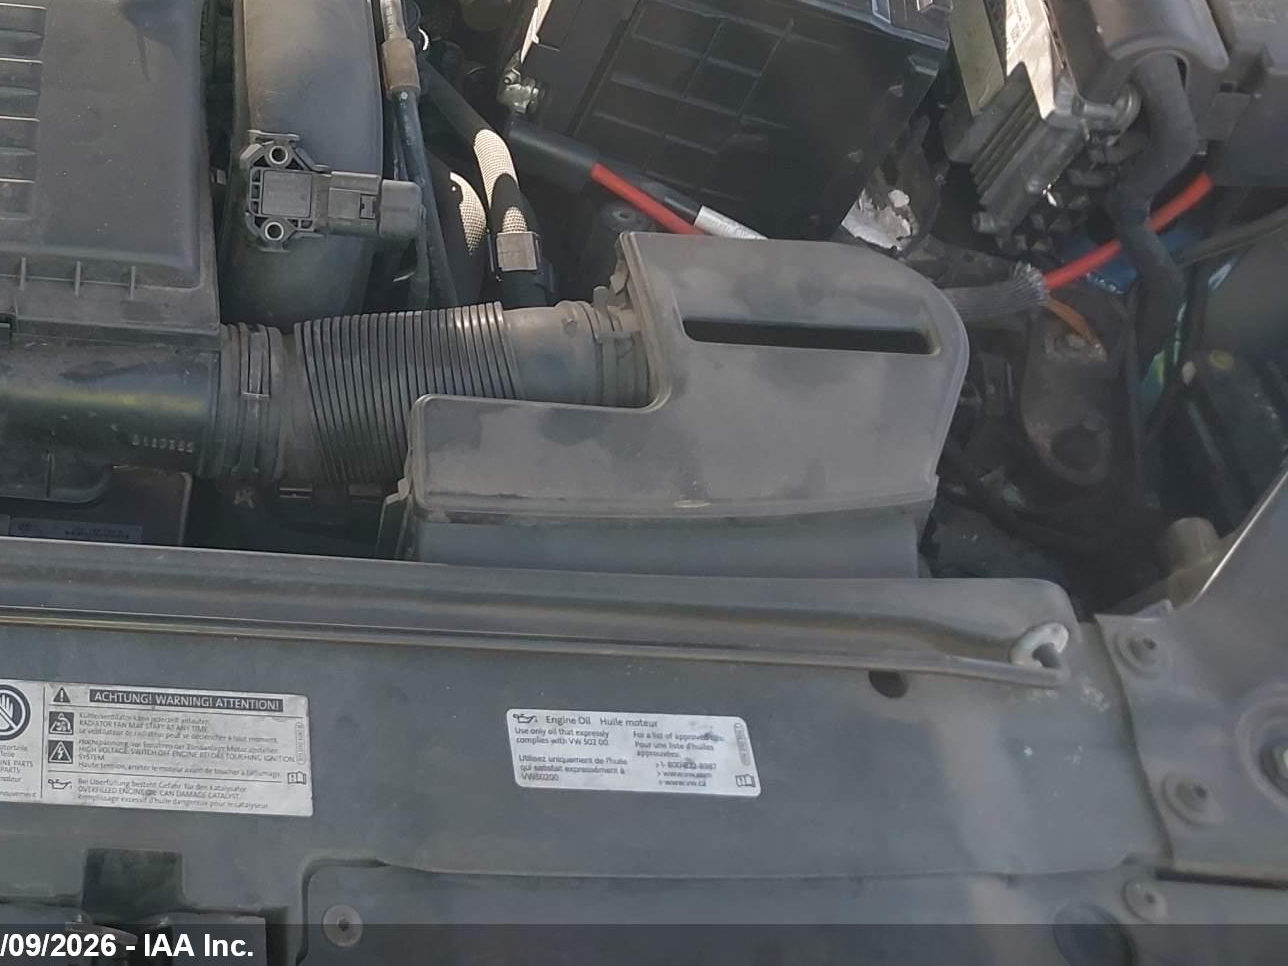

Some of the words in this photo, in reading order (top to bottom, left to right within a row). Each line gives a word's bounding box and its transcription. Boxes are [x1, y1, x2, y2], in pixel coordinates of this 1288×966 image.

[94, 691, 152, 704] ACHTUNG!
[155, 694, 212, 707] WARNING!
[215, 697, 279, 711] ATTENTION!
[546, 715, 576, 726] Engine
[578, 716, 591, 725] Oil
[600, 717, 623, 726] Huile
[626, 719, 658, 727] moteur
[530, 727, 546, 736] only
[548, 727, 557, 735] oil
[558, 728, 573, 736] that
[575, 729, 609, 738] expressly
